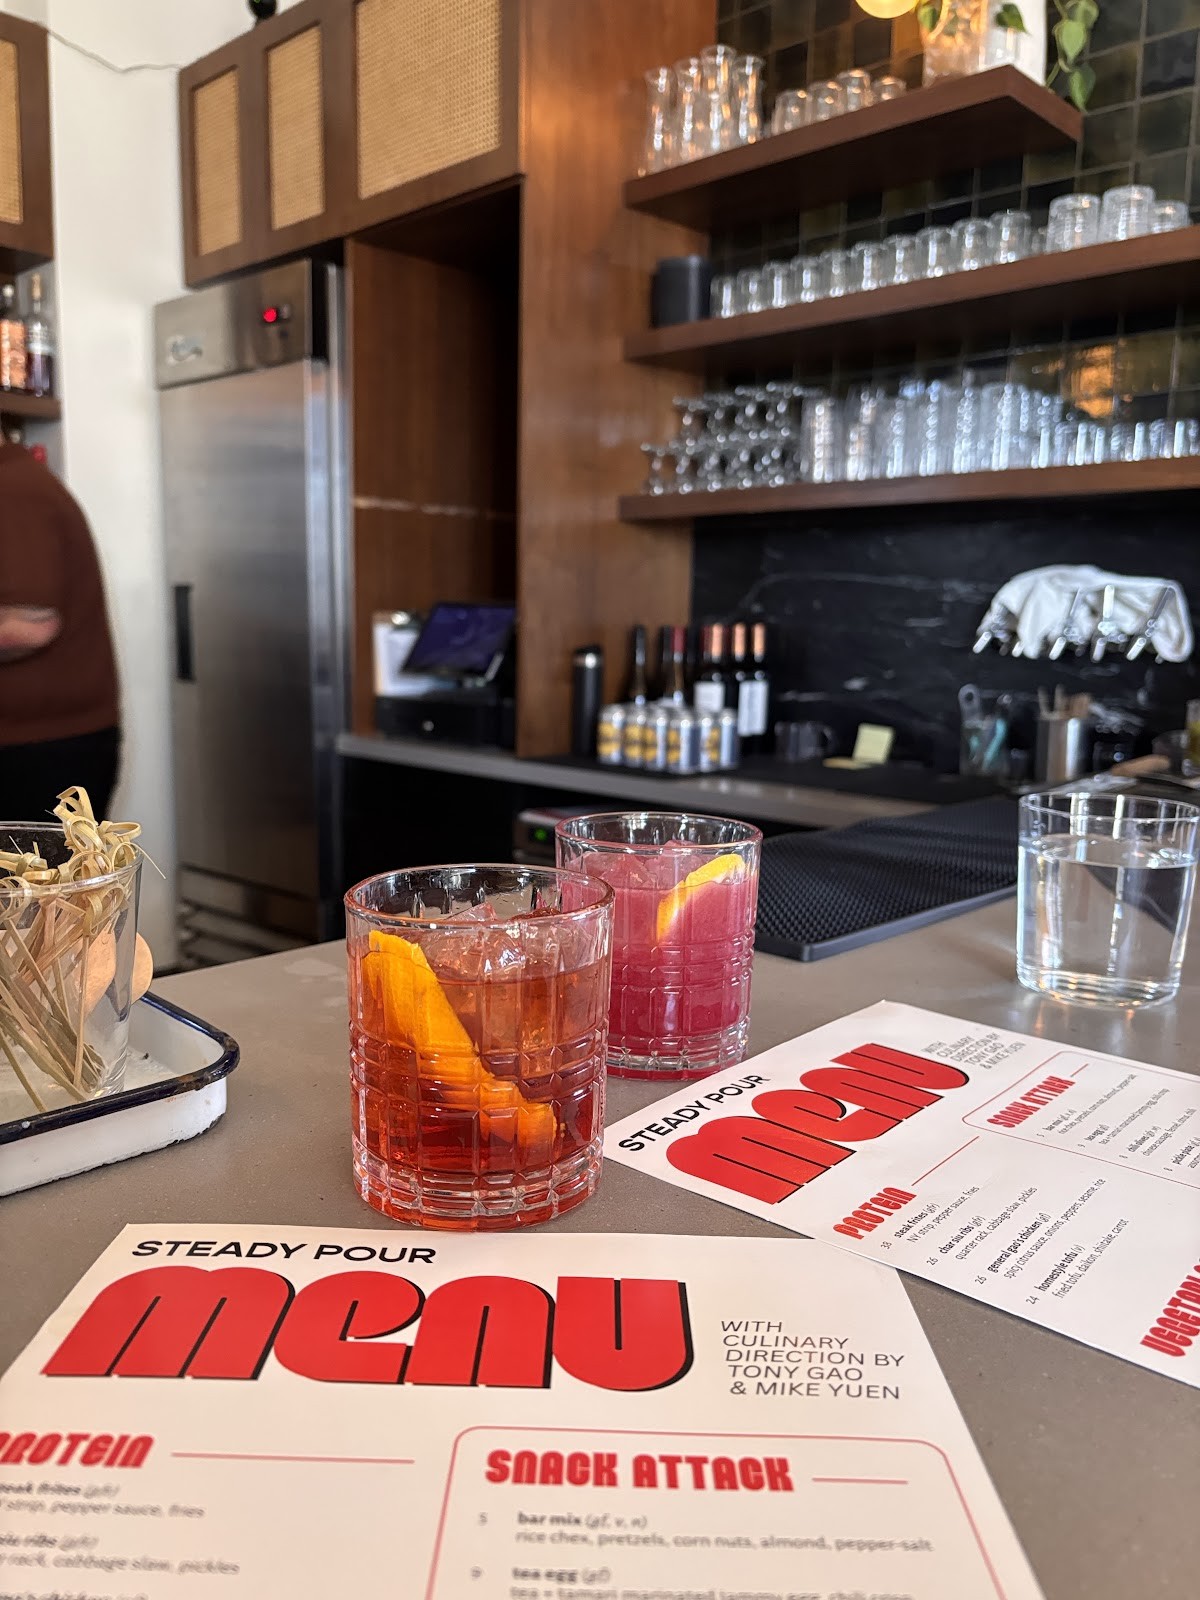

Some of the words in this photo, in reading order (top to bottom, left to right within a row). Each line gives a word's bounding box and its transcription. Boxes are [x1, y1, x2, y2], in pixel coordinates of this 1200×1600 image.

[618, 1100, 710, 1151] STEADY
[704, 1075, 770, 1104] POUR
[986, 1101, 1040, 1128] SNACK
[1020, 1076, 1075, 1106] ATTACK
[833, 1187, 917, 1240] PROTEIN
[894, 1224, 914, 1238] steak
[907, 1212, 928, 1225] frites
[906, 1233, 921, 1242] NY
[932, 1207, 953, 1224] pepper
[962, 1186, 980, 1196] fries
[955, 1240, 978, 1260] quarter
[986, 1212, 1010, 1230] cabbage
[1018, 1187, 1037, 1202] pickles
[132, 1239, 308, 1260] STEADY
[313, 1243, 437, 1264] POUR
[926, 1257, 938, 1266] 26
[938, 1241, 955, 1254] char
[951, 1234, 964, 1243] siu
[959, 1225, 974, 1236] ribs
[974, 1275, 987, 1284] 26
[987, 1250, 1012, 1273] general
[1006, 1238, 1024, 1254] gao's
[1018, 1221, 1042, 1240] chicken
[1003, 1264, 1023, 1279] spicy
[1016, 1250, 1035, 1266] citrus
[1052, 1282, 1072, 1298] fried
[1111, 1219, 1129, 1234] carrot
[1025, 1296, 1040, 1304] 24
[1034, 1262, 1068, 1292] homestyle
[1061, 1252, 1078, 1264] tofu
[721, 1320, 783, 1332] WITH
[723, 1335, 849, 1349] CULINARY
[725, 1350, 864, 1365] DIRECTION
[874, 1353, 904, 1367] BY
[728, 1365, 799, 1378] TONY
[807, 1367, 863, 1381] GAO
[730, 1381, 747, 1395] &
[756, 1382, 820, 1397] MIKE
[828, 1383, 899, 1399] YUEN
[0, 1432, 155, 1468] ROTEIN
[485, 1449, 618, 1488] SNACK
[632, 1454, 794, 1492] ATTACK
